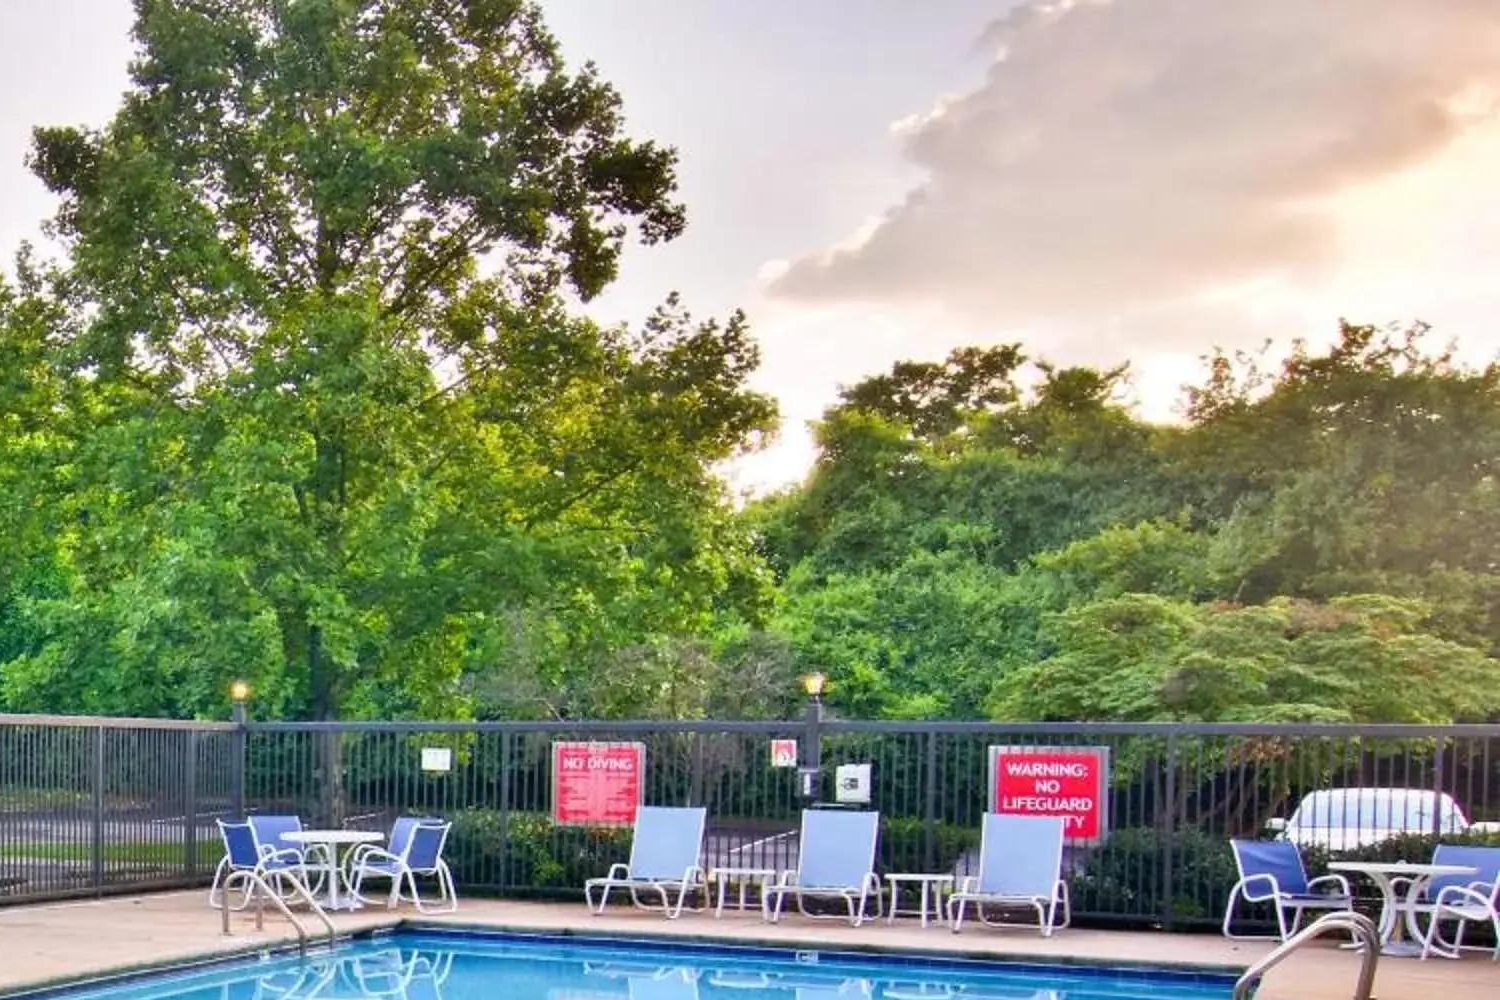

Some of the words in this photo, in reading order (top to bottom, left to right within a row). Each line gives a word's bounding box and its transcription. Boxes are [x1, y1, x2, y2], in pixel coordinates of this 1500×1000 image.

[563, 757, 583, 769] NO
[587, 757, 633, 769] DIVING
[1035, 779, 1061, 793] NO
[1002, 795, 1093, 811] LIFEGUARD
